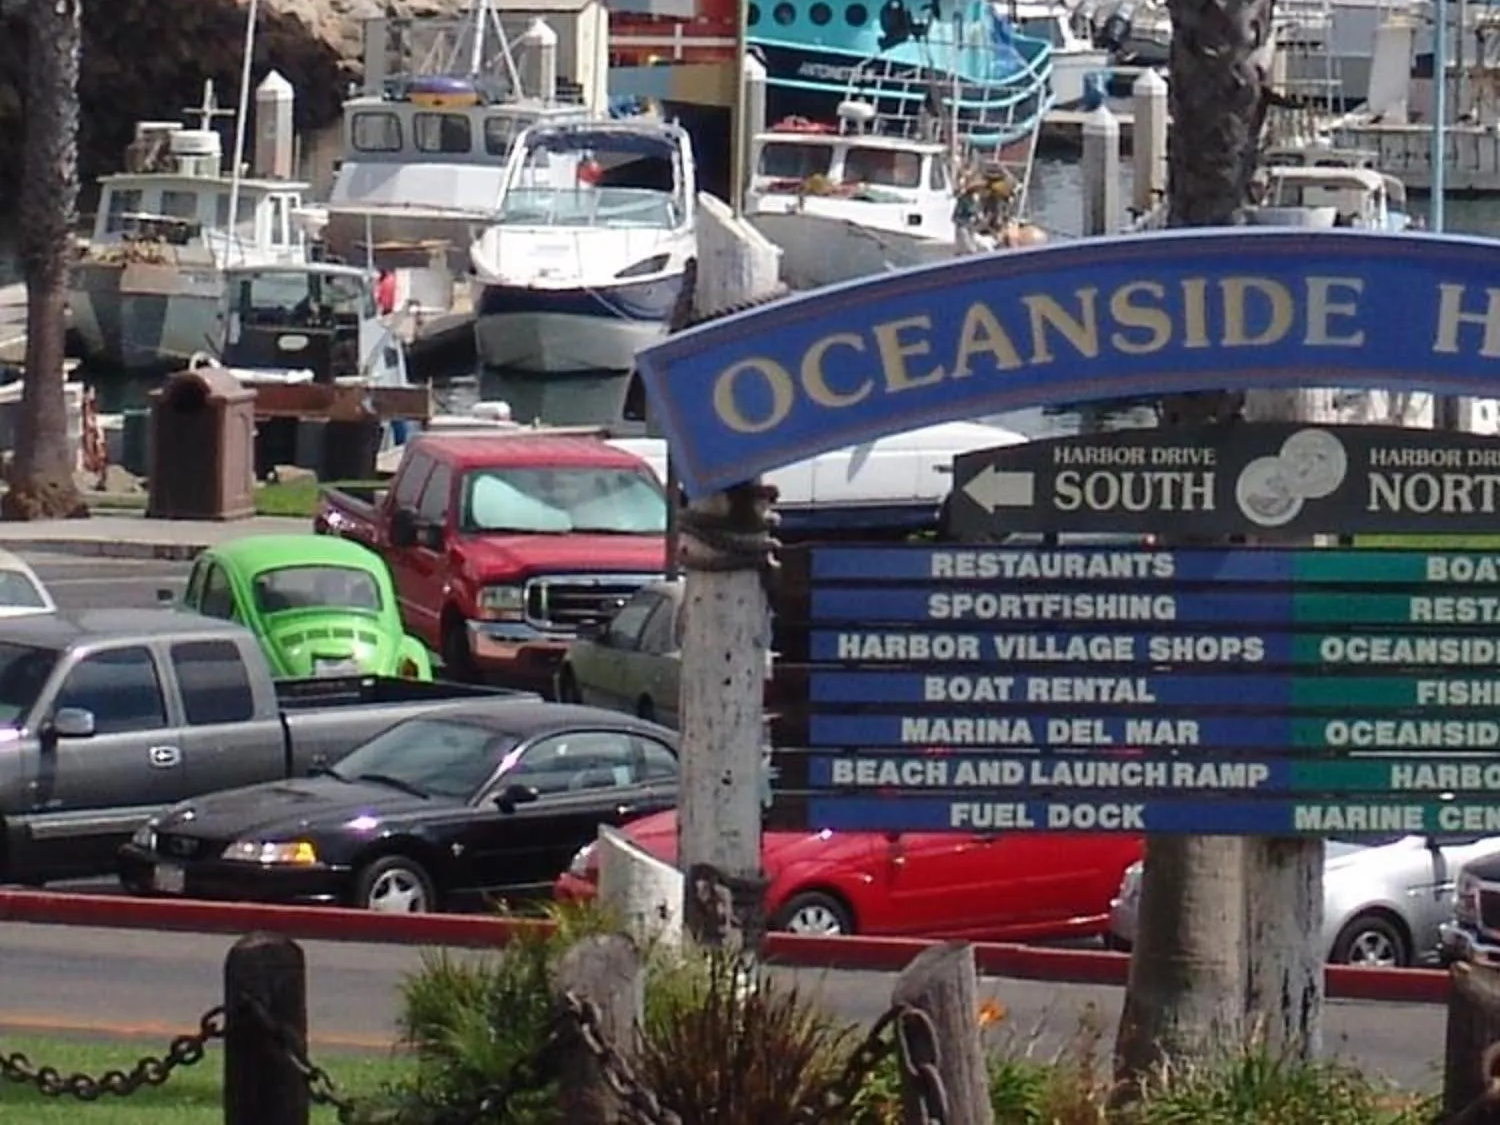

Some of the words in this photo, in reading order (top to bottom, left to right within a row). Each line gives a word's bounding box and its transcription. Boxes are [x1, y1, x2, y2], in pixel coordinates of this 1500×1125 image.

[713, 277, 1365, 435] OCEANSIDE
[1053, 446, 1148, 465] HARBOR
[1151, 447, 1216, 466] DRIVE
[1369, 448, 1462, 467] HARBOR
[1053, 470, 1215, 511] SOUTH
[931, 551, 1175, 578] RESTAURANTS
[928, 592, 1176, 620] SPORTFISHING
[837, 634, 980, 660] HARBOR
[993, 635, 1135, 661] VILLAGE
[1149, 636, 1265, 662] SHOPS
[924, 676, 1015, 702] BOAT
[1027, 677, 1156, 703] RENTAL
[901, 717, 1033, 744] MARINA
[1047, 719, 1113, 745] DEL
[1125, 719, 1199, 745] MAR
[832, 759, 948, 786] BEACH
[953, 760, 1025, 786] AND
[1030, 760, 1167, 787] LAUNCH
[1172, 762, 1269, 788] RAMP
[950, 802, 1035, 828] FUEL
[1048, 803, 1145, 829] DOCK
[1294, 805, 1424, 831] MARINE
